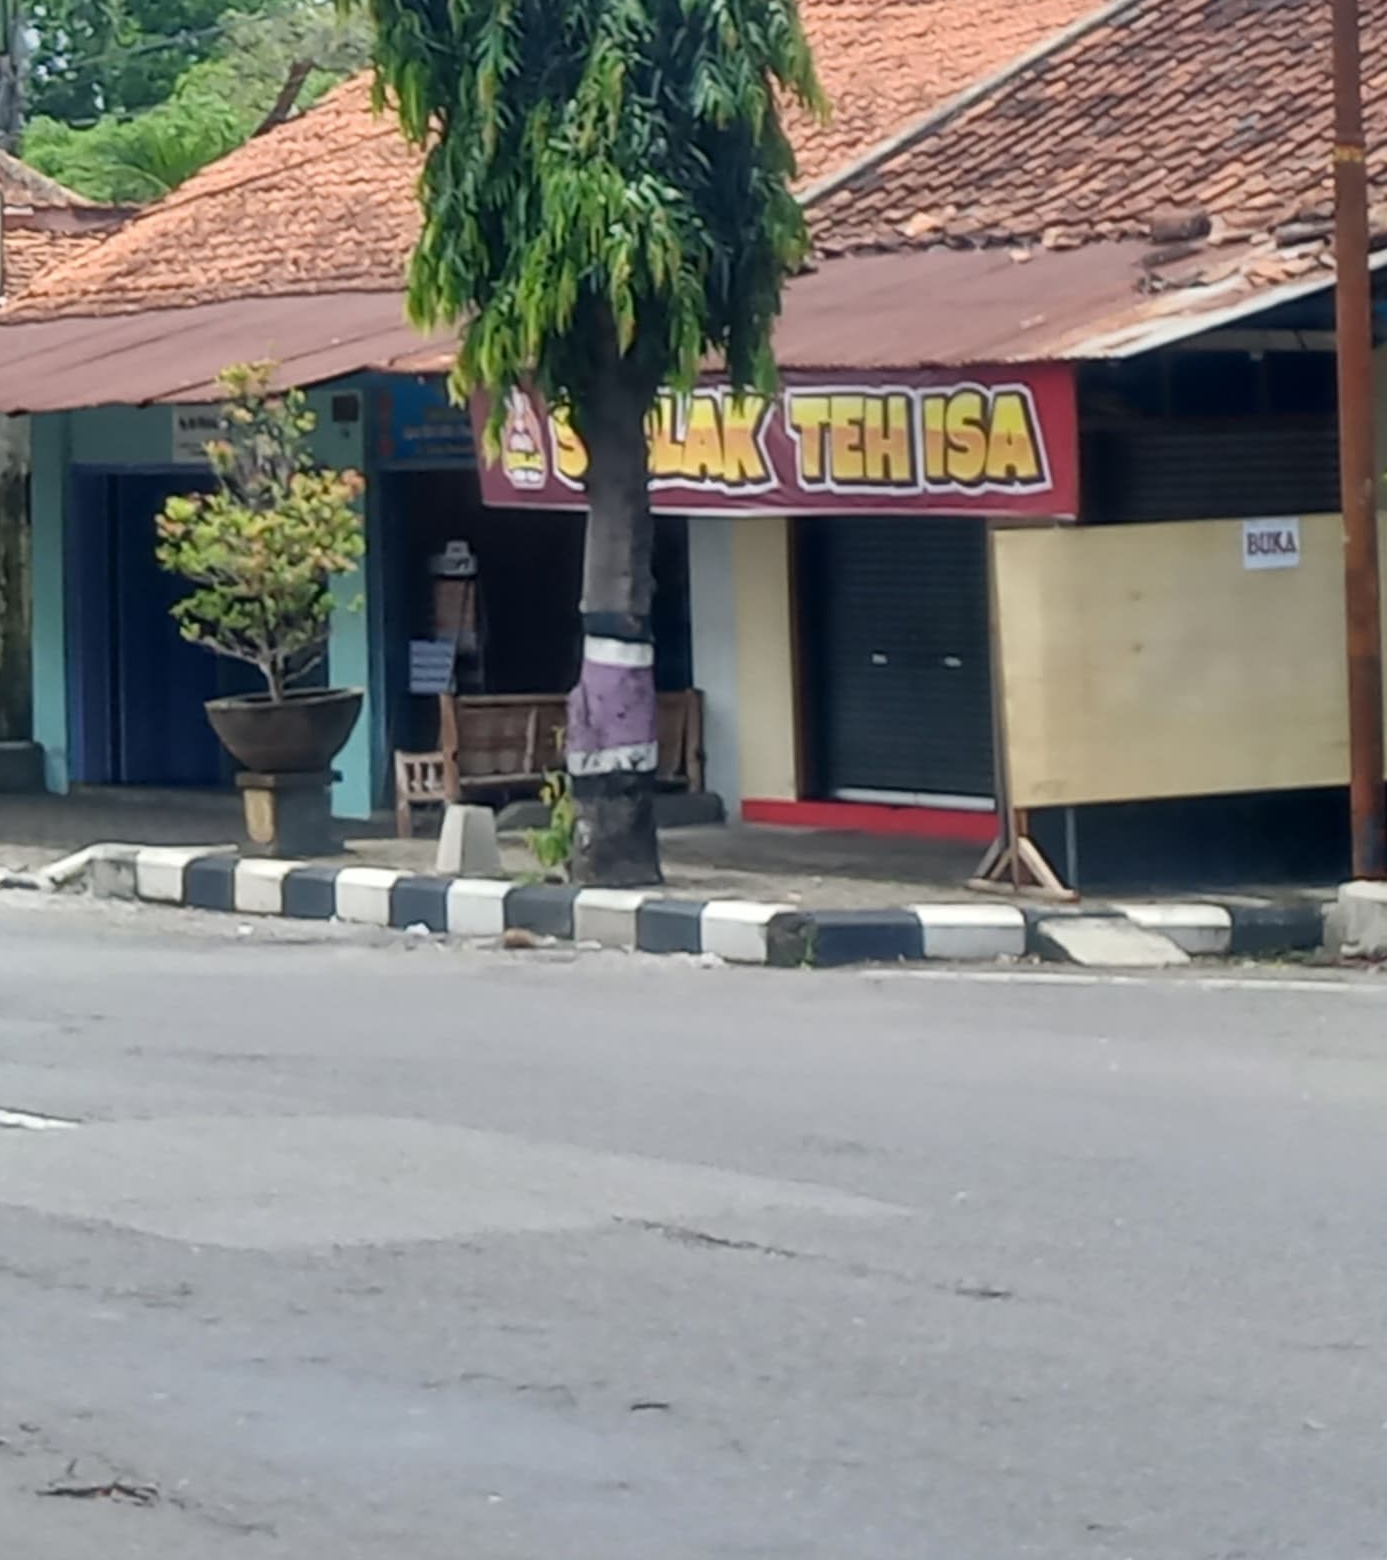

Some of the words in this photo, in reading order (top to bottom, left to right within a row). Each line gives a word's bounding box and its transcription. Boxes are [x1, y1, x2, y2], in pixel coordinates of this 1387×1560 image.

[547, 388, 775, 486] SLAK
[782, 385, 916, 494] TEH
[920, 383, 1053, 494] ISA
[1246, 530, 1297, 556] BUKA
